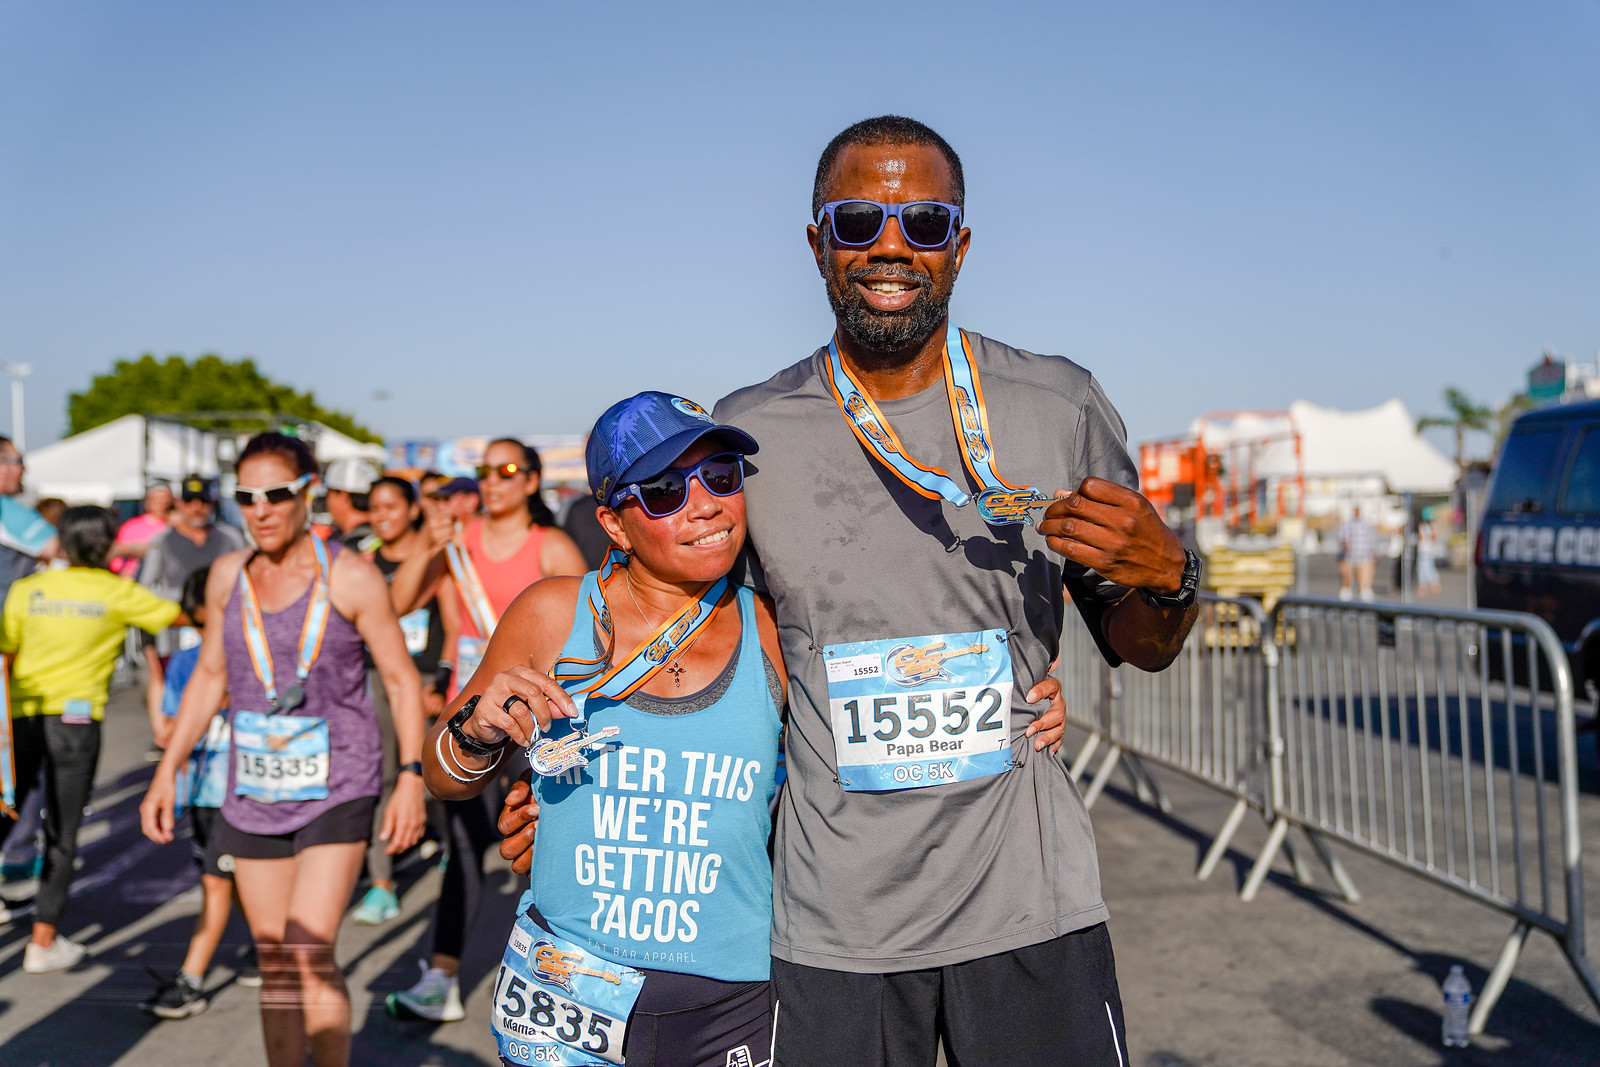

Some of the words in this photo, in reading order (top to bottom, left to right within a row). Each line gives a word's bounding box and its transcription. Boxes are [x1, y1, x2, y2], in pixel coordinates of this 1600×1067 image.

[954, 386, 979, 430] 2019
[861, 420, 899, 452] 2019
[985, 493, 1033, 507] OC
[992, 505, 1032, 517] 5K
[1488, 524, 1555, 563] race
[1556, 526, 1600, 567] ce
[669, 603, 702, 644] 2019
[895, 642, 946, 667] OC
[854, 666, 879, 676] 15552
[903, 657, 946, 678] 5K
[843, 687, 1003, 743] 15552
[886, 743, 924, 757] Papa
[929, 738, 964, 754] Bear
[243, 754, 319, 779] 15335
[681, 751, 761, 802] THIS
[893, 764, 923, 783] OC
[928, 761, 954, 779] 5K
[592, 793, 711, 847] WE'RE
[575, 844, 722, 895] GETTING
[590, 891, 700, 943] TACOS
[513, 939, 527, 953] 15835
[535, 946, 584, 967] OC
[587, 938, 607, 953] FAT
[613, 947, 636, 960] BAR
[643, 951, 697, 963] APPAREL
[537, 961, 574, 978] 5K
[493, 966, 613, 1054] 15835
[503, 1017, 537, 1035] Mama
[509, 1041, 530, 1061] OC
[535, 1045, 560, 1061] 5K
